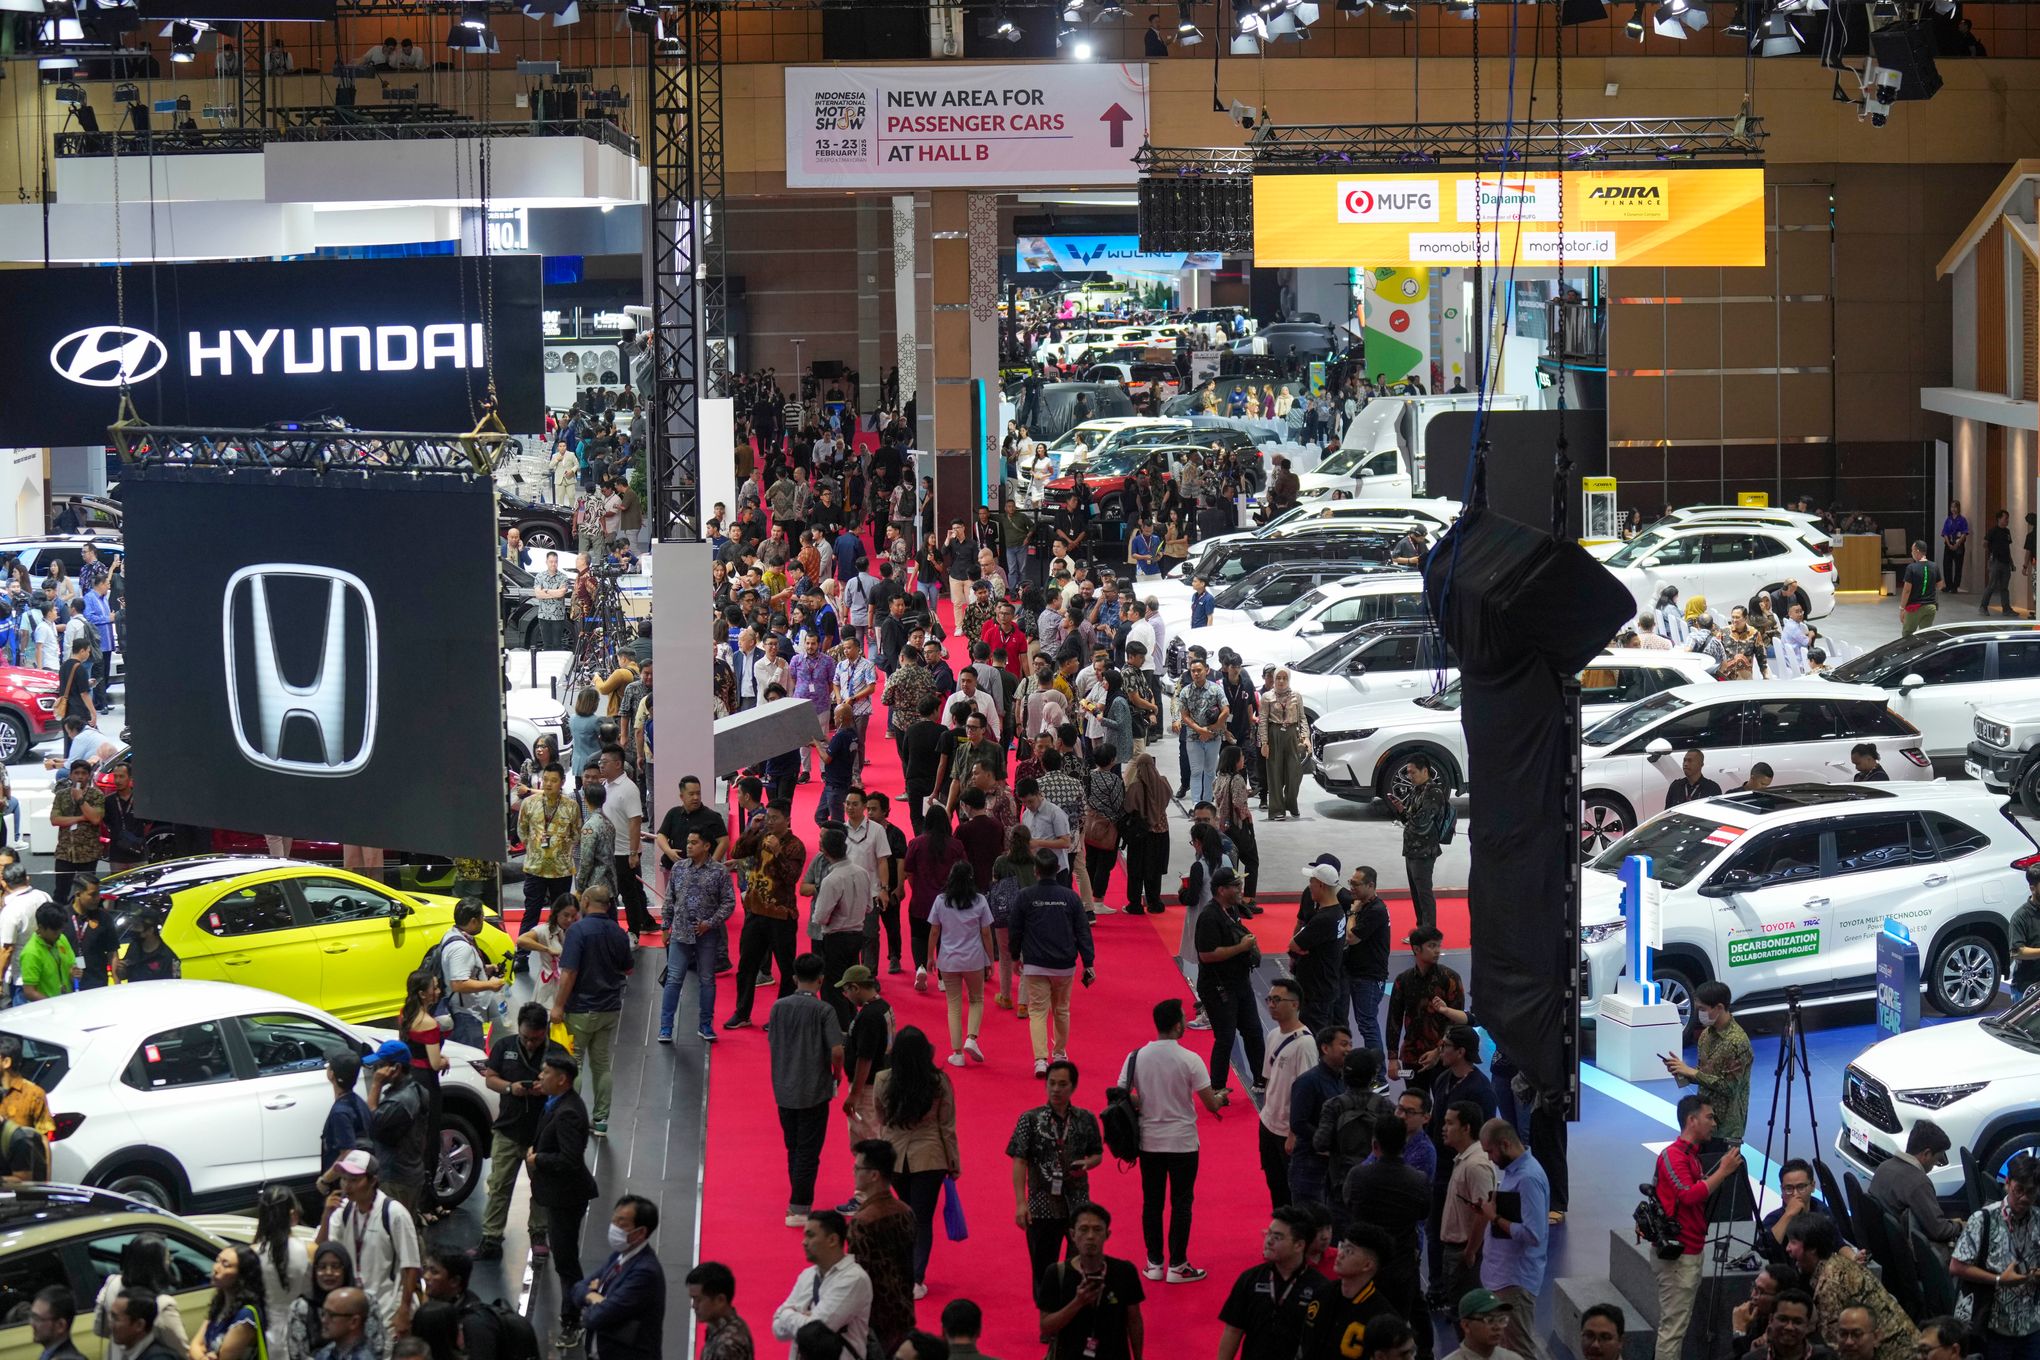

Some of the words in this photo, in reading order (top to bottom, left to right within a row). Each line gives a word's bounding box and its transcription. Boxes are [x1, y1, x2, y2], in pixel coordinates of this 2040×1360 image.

[887, 90, 938, 107] NEW
[941, 90, 998, 107] AREA
[1003, 89, 1044, 106] FOR
[816, 106, 866, 117] MOTOR
[816, 118, 865, 130] SHOW
[887, 115, 1005, 132] PASSENGER
[1010, 114, 1065, 131] CARS
[816, 139, 830, 149] 13
[842, 139, 857, 149] 23
[887, 145, 914, 162] AT
[919, 144, 971, 162] HALL
[976, 144, 989, 161] B
[1482, 193, 1536, 204] Danamon
[1588, 186, 1660, 198] ADIRA
[1378, 193, 1431, 210] MUFG
[188, 322, 484, 376] HYUNDAI
[1761, 921, 1796, 932] TOYOTA
[1840, 919, 1864, 928] TOYOTA
[1885, 909, 1932, 920] TECHNOLOGY
[1731, 933, 1817, 953] DECARBONIZATION
[1844, 934, 1863, 942] Green
[1731, 948, 1788, 962] COLLABORATION
[1788, 944, 1816, 954] PROJECT
[1879, 982, 1894, 1008] CAR
[1879, 1003, 1901, 1035] YEAR
